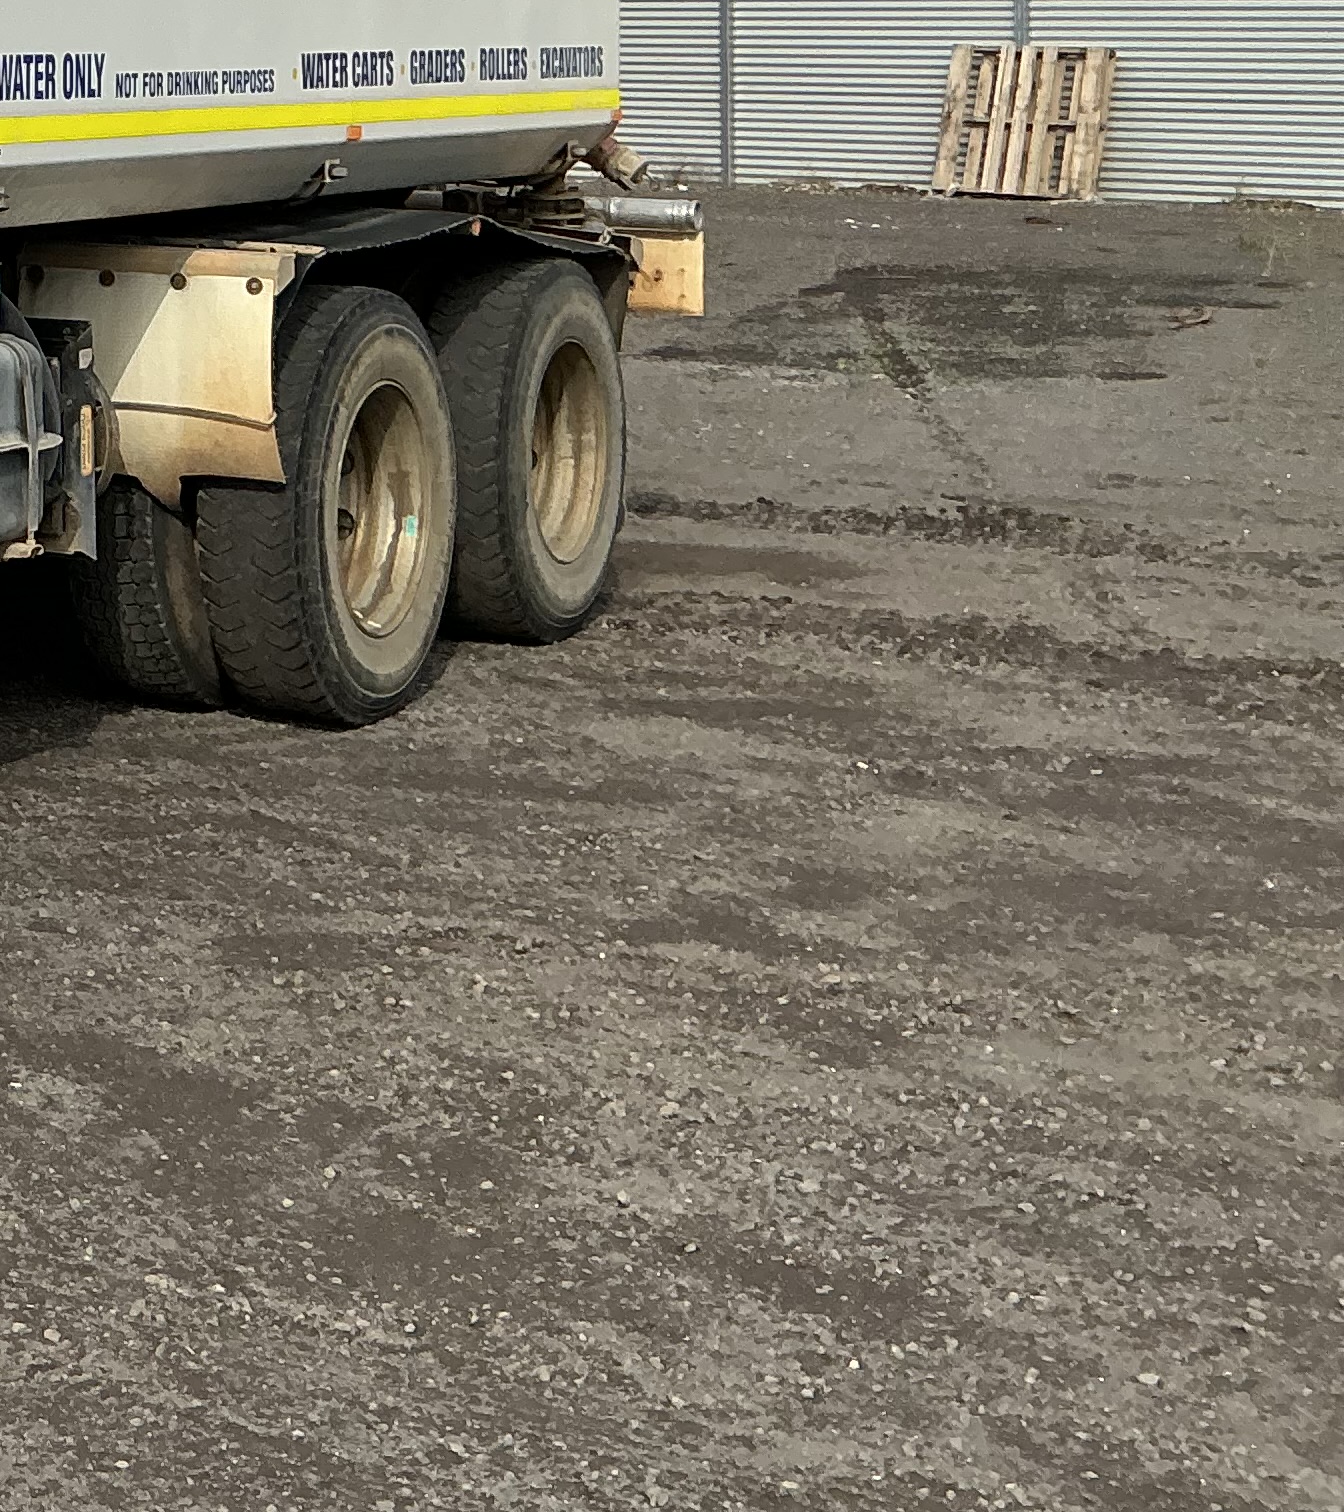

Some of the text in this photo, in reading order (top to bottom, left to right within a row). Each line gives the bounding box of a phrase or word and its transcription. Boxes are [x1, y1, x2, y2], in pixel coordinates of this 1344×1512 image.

[62, 52, 105, 100] ONLY
[115, 68, 275, 99] NOT FOR DRINKING PURPOSES
[301, 45, 603, 90] WATER CARTS GRADERS ROLLERS EXCAVATORS
